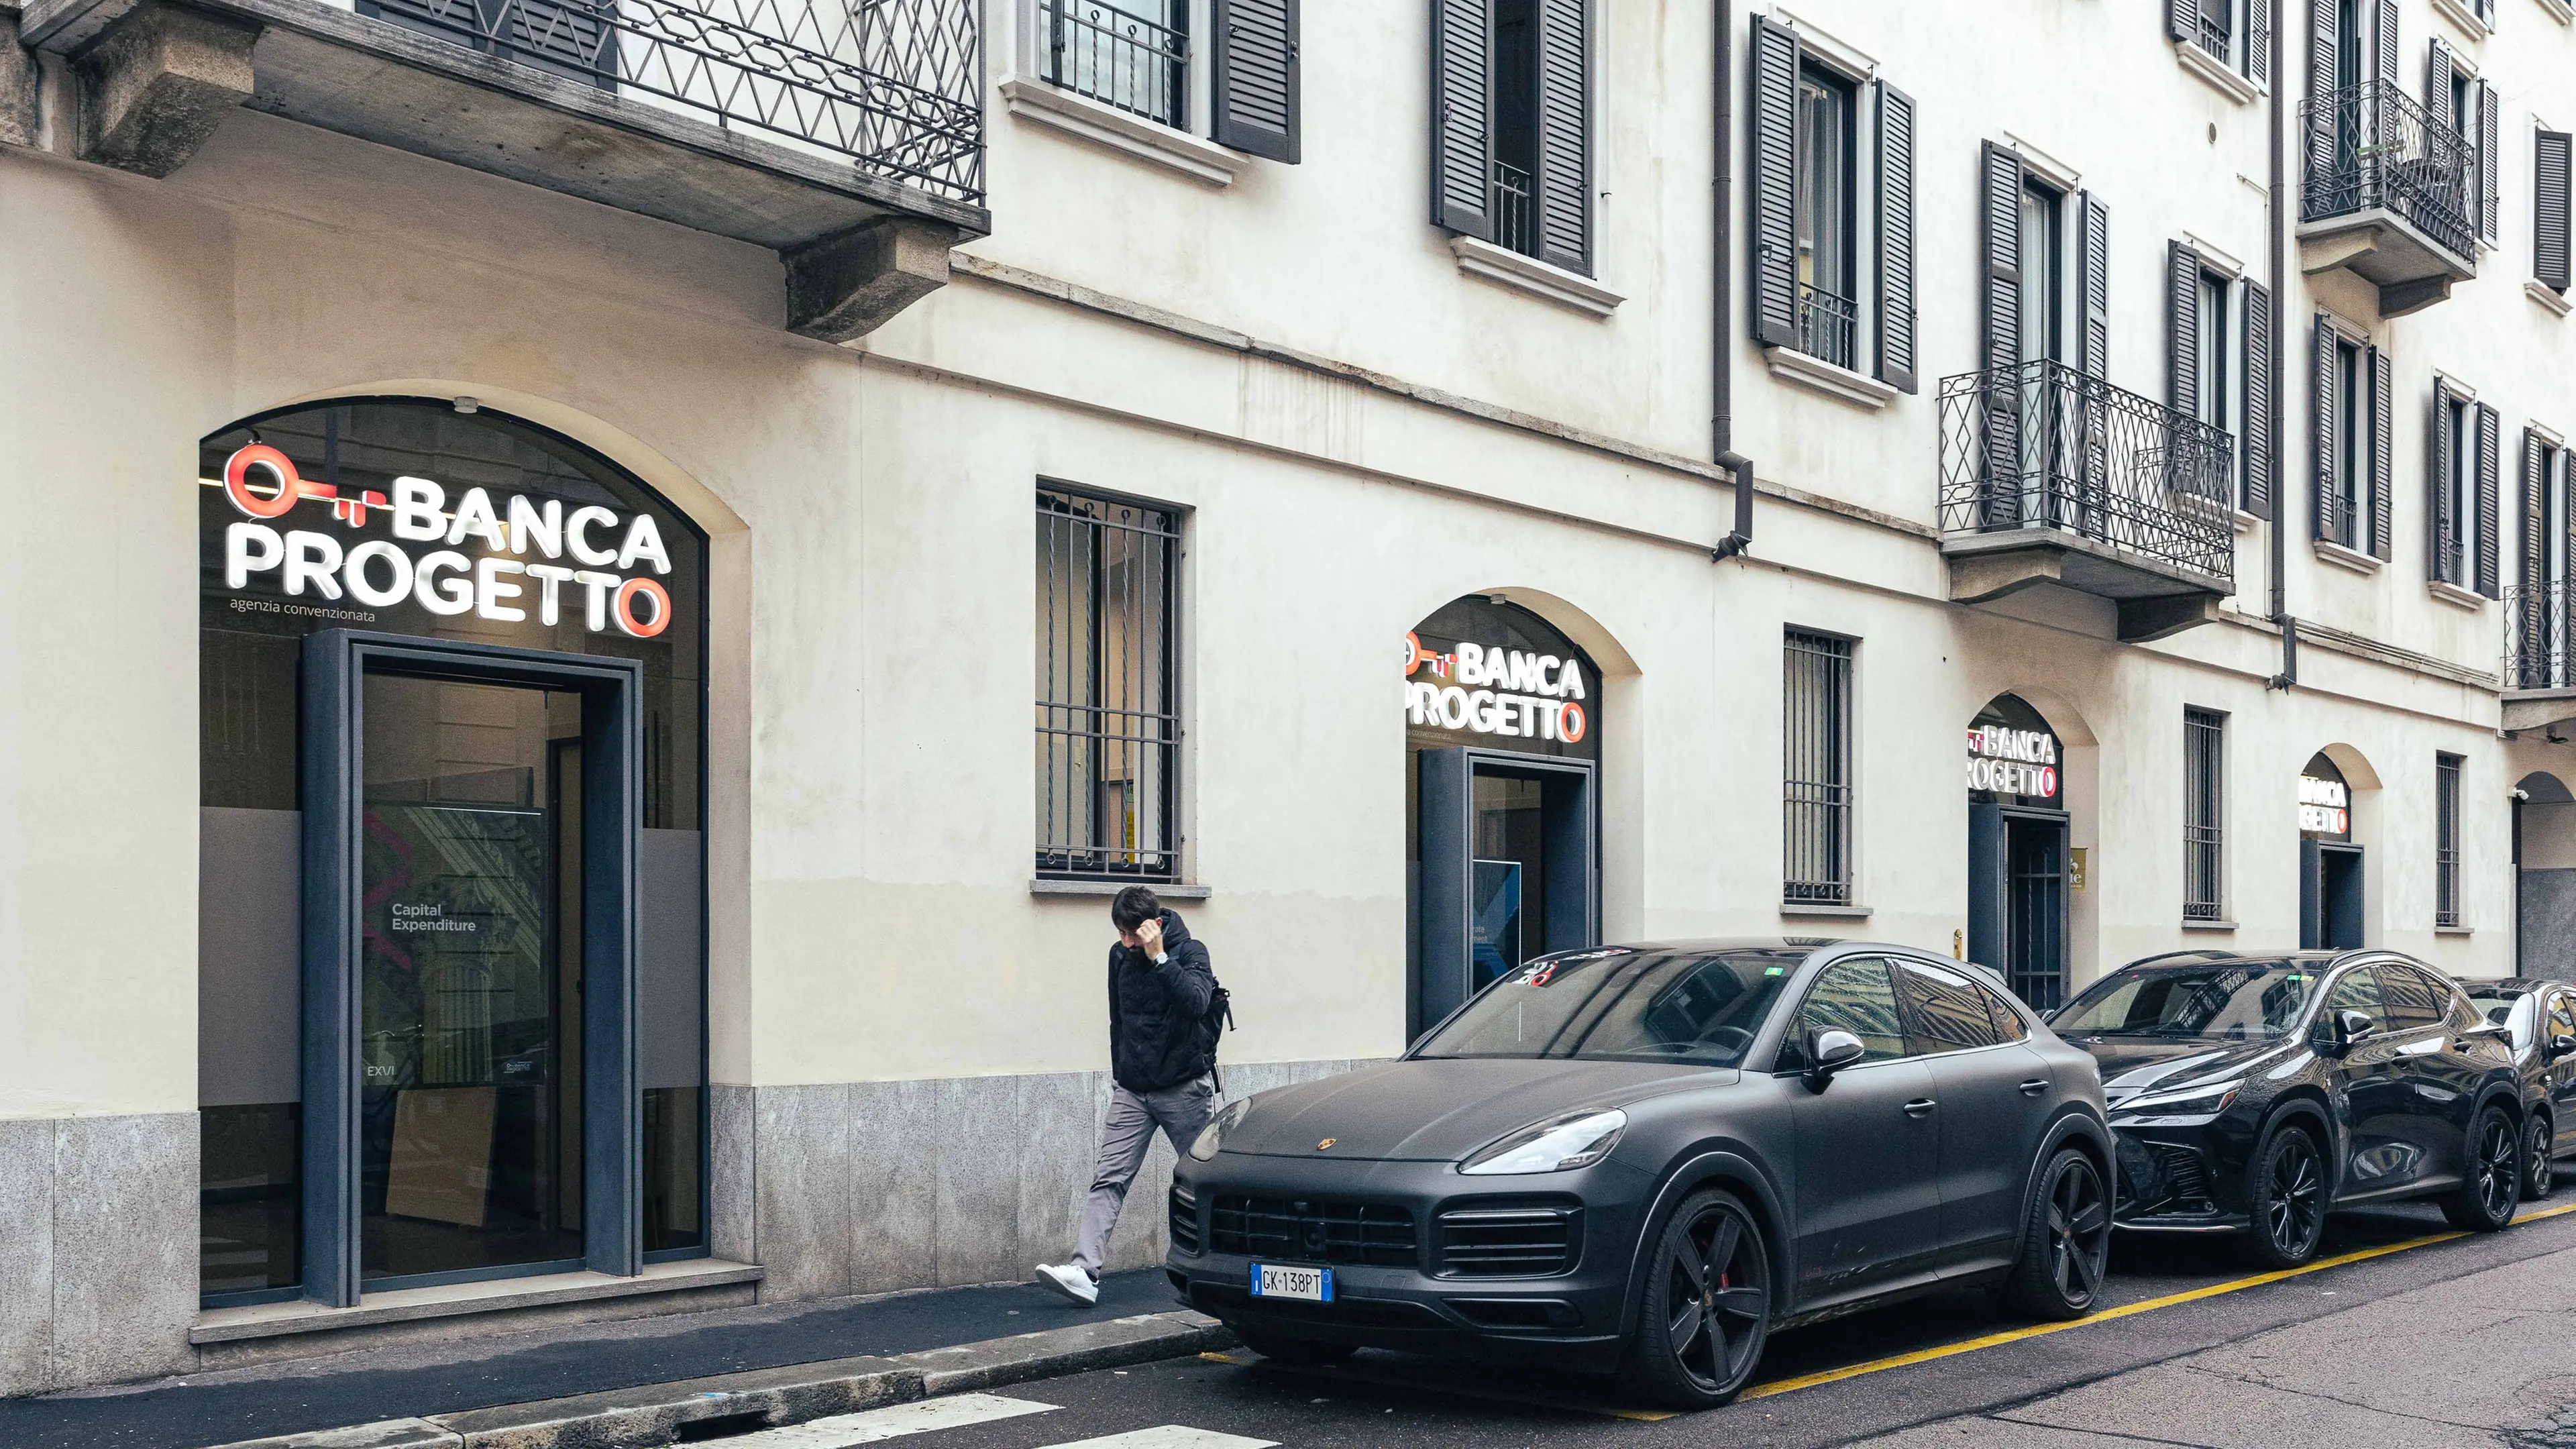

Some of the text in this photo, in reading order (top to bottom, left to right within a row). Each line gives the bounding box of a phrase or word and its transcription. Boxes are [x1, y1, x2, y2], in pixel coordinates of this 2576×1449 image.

[392, 476, 672, 575] BANCA
[225, 522, 672, 637] PROGETTO
[230, 598, 375, 623] agenzia convenzionata
[1455, 642, 1585, 700] BANCA
[1980, 724, 2056, 764] BANCA
[1967, 756, 2057, 797] ROGETTO
[392, 903, 441, 918] Capital
[392, 918, 476, 932] Expenditure
